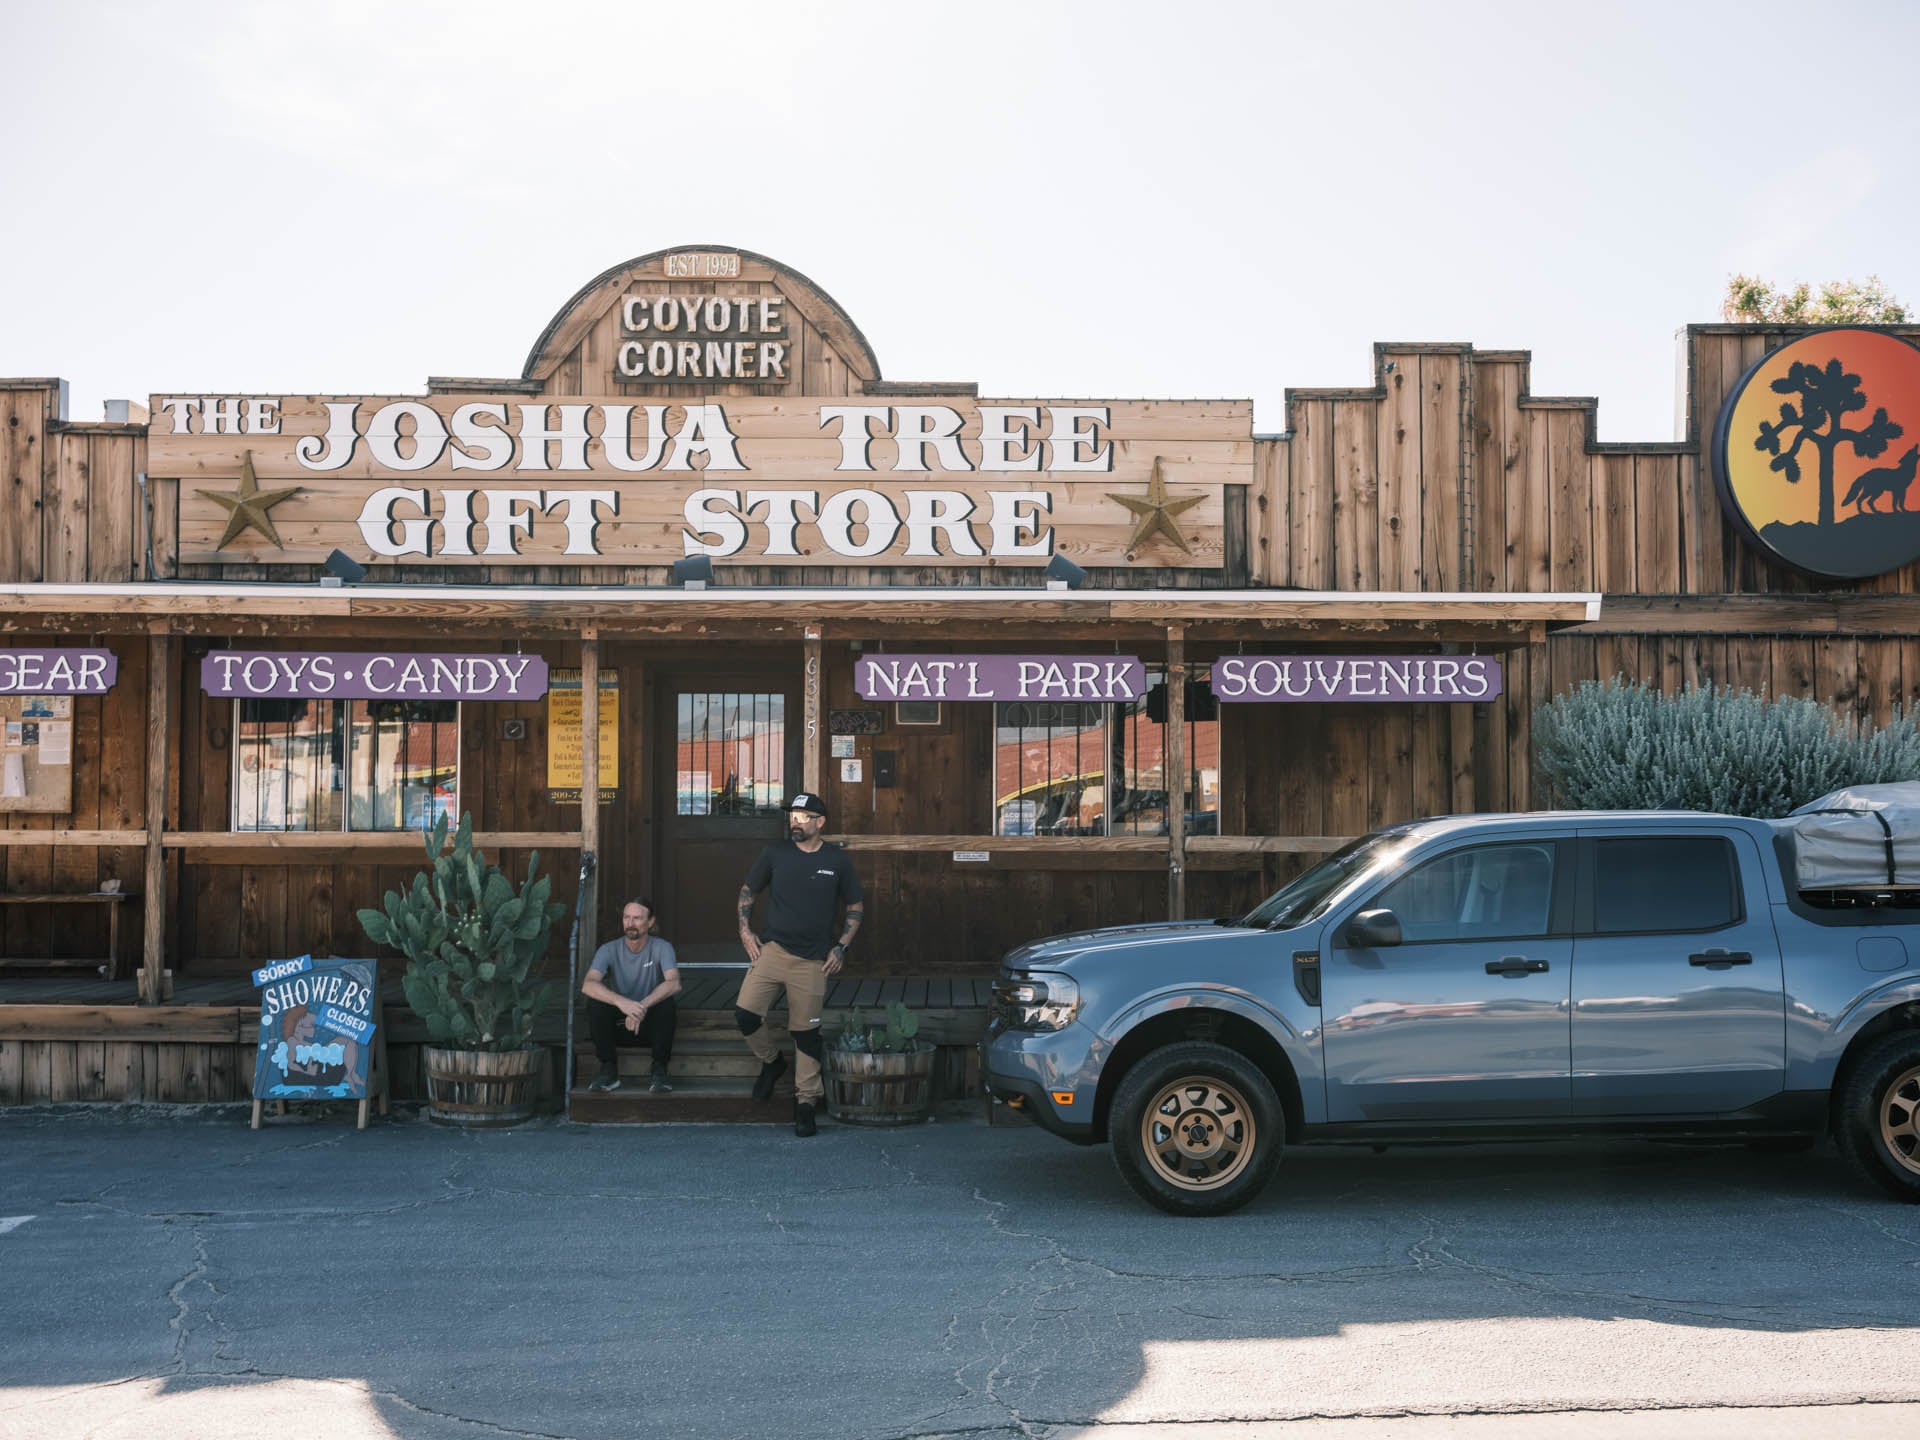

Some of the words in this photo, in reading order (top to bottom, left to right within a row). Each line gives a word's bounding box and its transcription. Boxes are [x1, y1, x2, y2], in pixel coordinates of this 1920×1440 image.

[668, 255, 699, 276] EST
[706, 255, 737, 276] 1994
[623, 296, 782, 333] COYOTE
[617, 340, 786, 378] CORNER
[163, 398, 283, 435] THE
[295, 402, 750, 472] JOSHUA
[820, 405, 1114, 473] TREE
[356, 487, 620, 558] GIFT
[682, 488, 1055, 558] STORE
[866, 661, 994, 698] NAT'L
[1018, 662, 1135, 699] PARK
[1220, 659, 1490, 698] SOUVENIRS
[258, 957, 306, 983] SORRY
[265, 975, 372, 1014] SHOWERS
[326, 1007, 367, 1032] CLOSED
